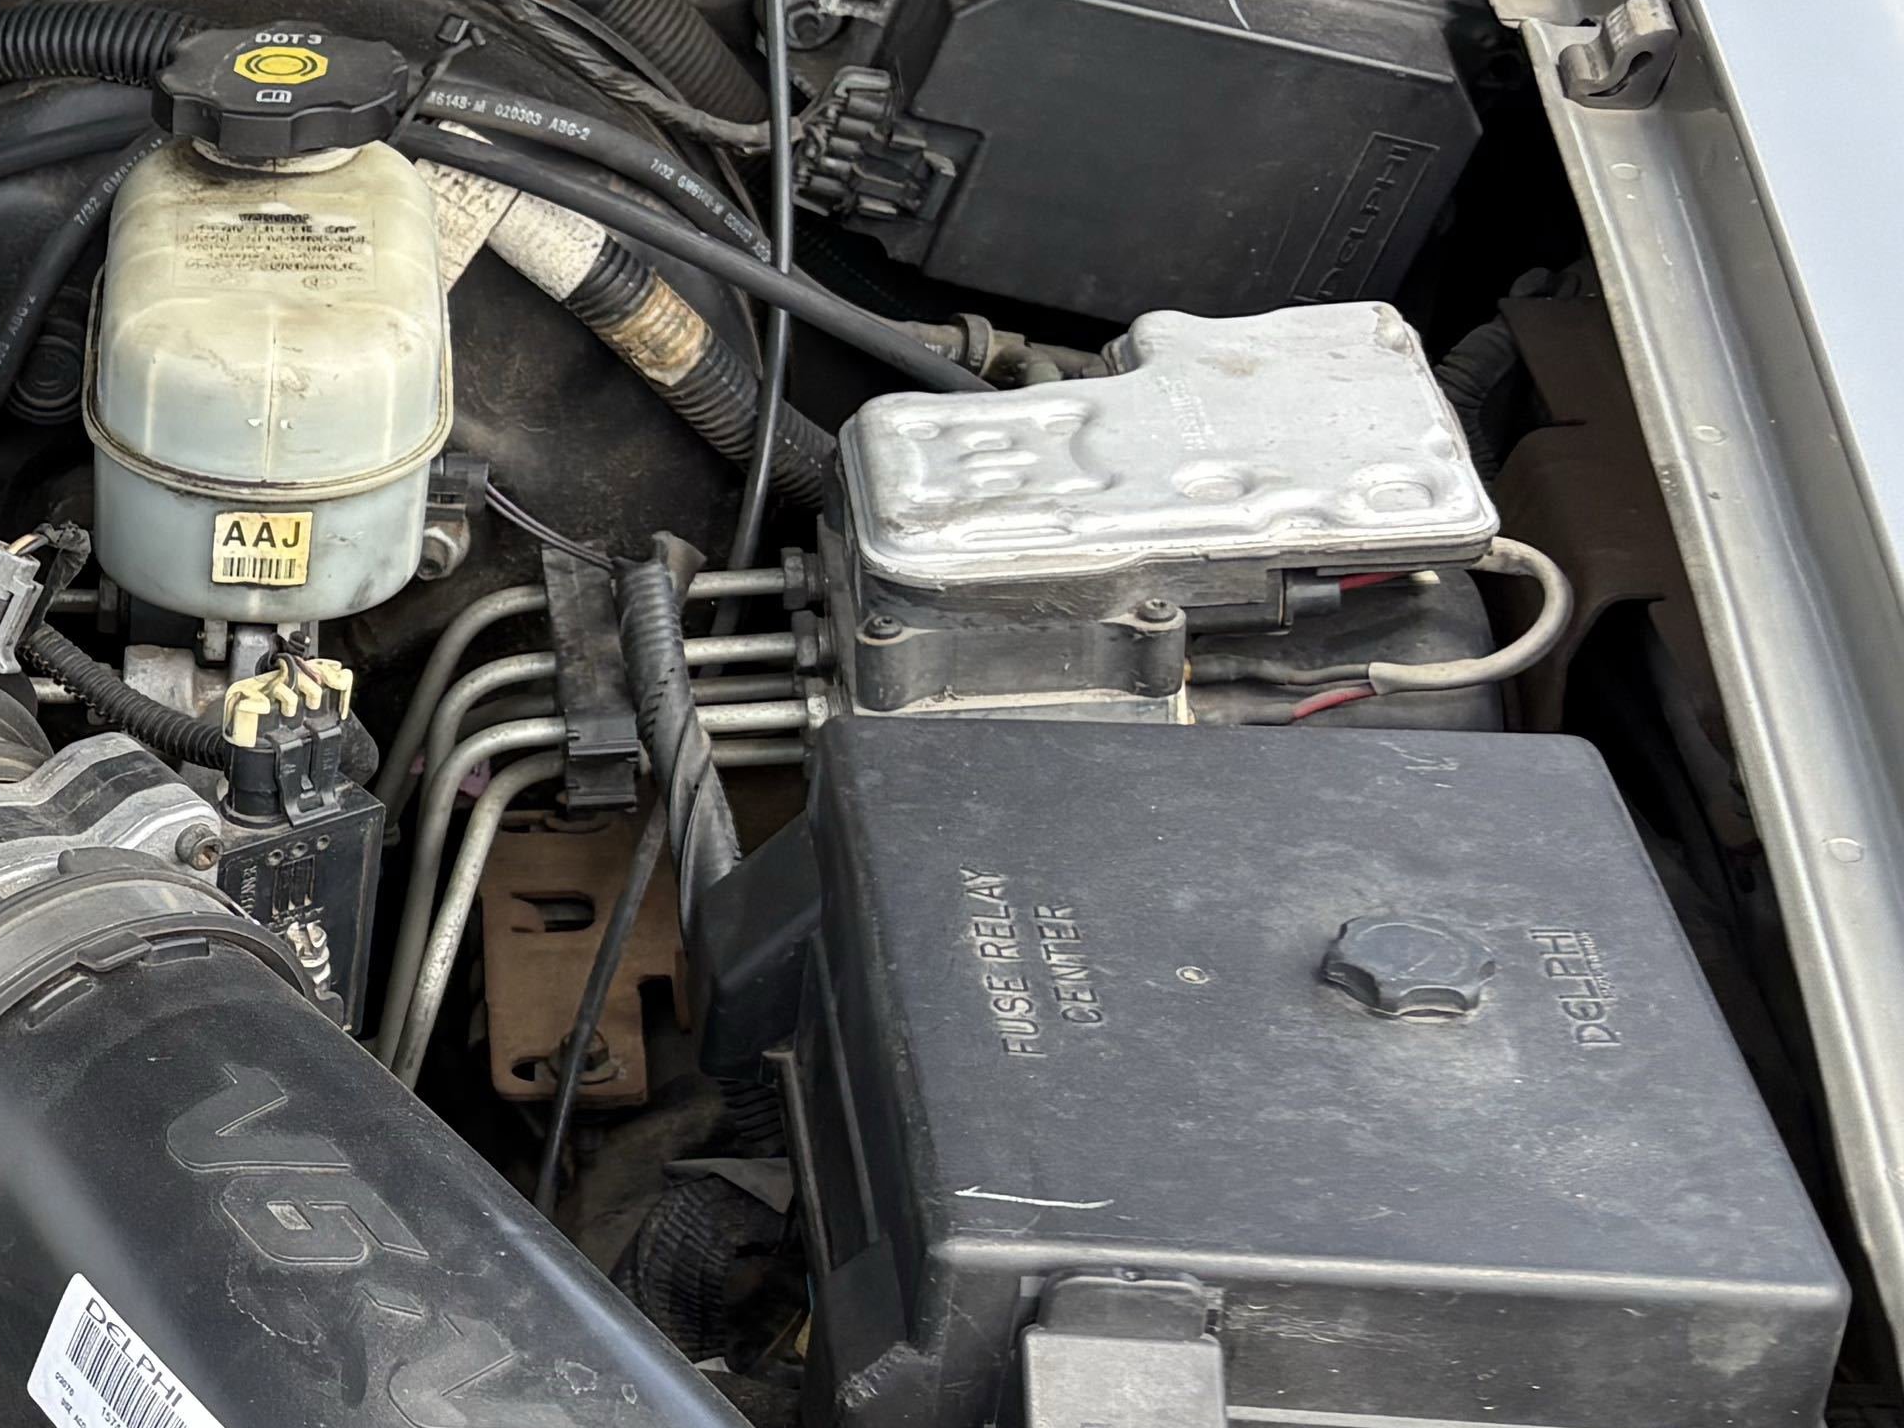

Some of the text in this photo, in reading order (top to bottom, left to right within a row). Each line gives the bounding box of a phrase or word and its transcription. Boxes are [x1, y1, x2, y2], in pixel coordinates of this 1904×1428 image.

[255, 32, 322, 45] DOT 3
[1313, 143, 1414, 299] DELPHI
[222, 520, 301, 549] AAJ
[959, 863, 1047, 1057] FUSE RELAY
[1033, 903, 1104, 1026] CENTER
[1527, 927, 1622, 1045] DELPHI
[85, 1297, 183, 1408] DELPHI
